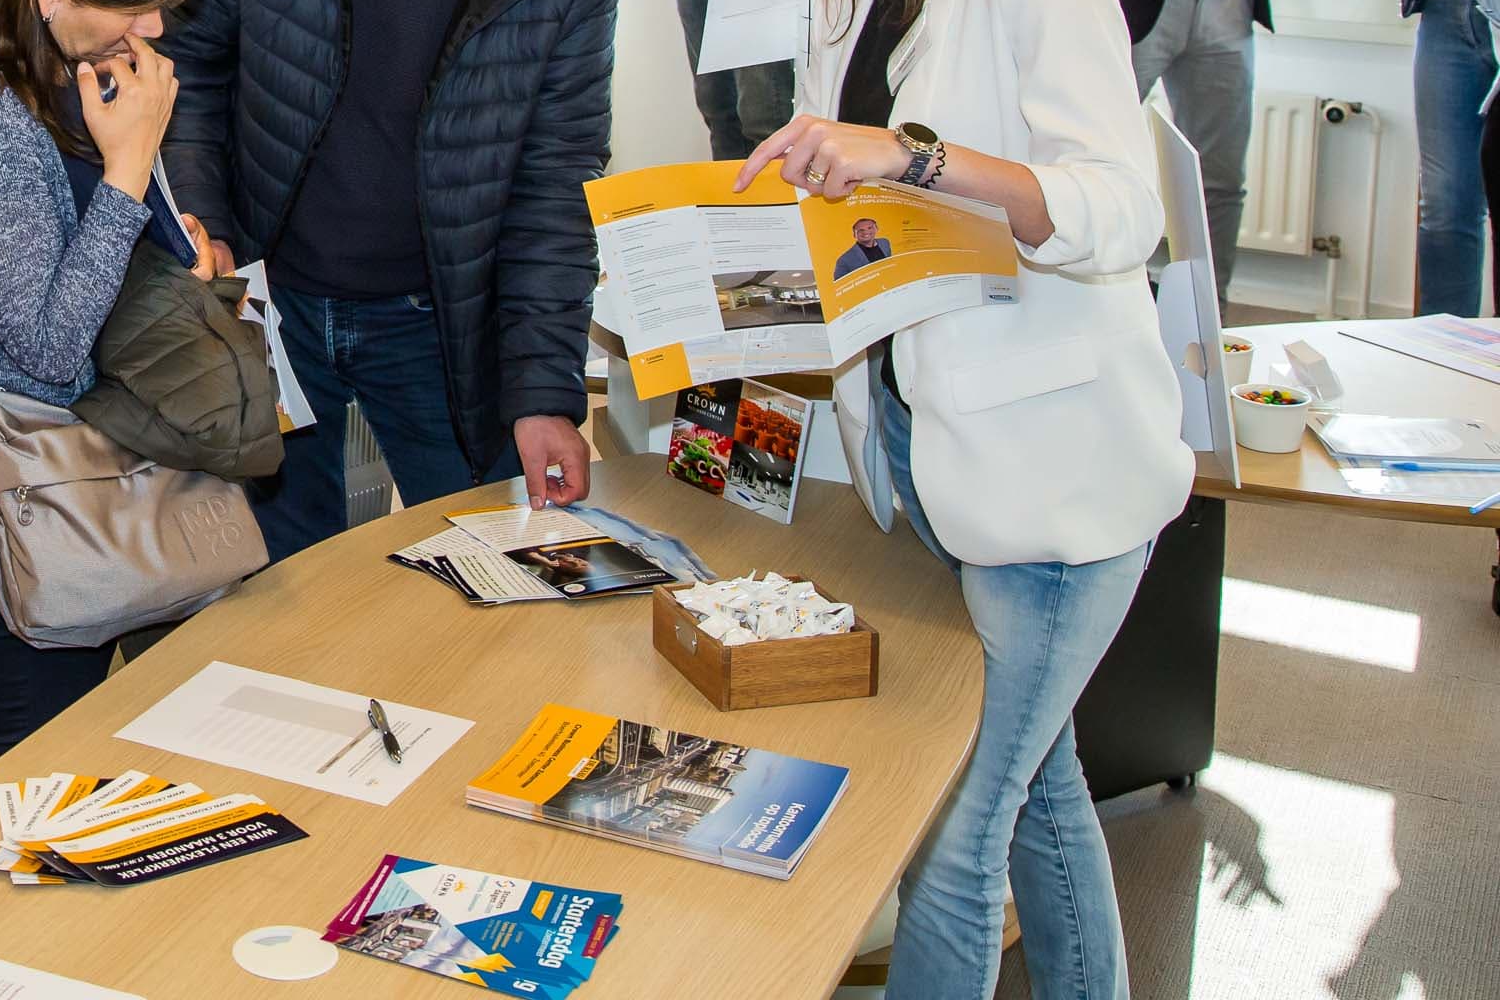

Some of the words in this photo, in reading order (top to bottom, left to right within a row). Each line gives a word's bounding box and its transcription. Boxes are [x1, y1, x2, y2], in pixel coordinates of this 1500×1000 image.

[687, 393, 727, 416] CROWN
[760, 802, 783, 816] op
[224, 820, 267, 836] VOOR
[245, 827, 278, 841] WIN
[736, 815, 775, 849] toplocatie
[754, 802, 806, 853] Kantoorruimte
[145, 836, 215, 861] MAANDEN
[217, 836, 247, 849] EEN
[116, 845, 219, 879] FLEXWERKPLEK
[433, 872, 459, 897] CROWN
[536, 895, 594, 970] Startersdag
